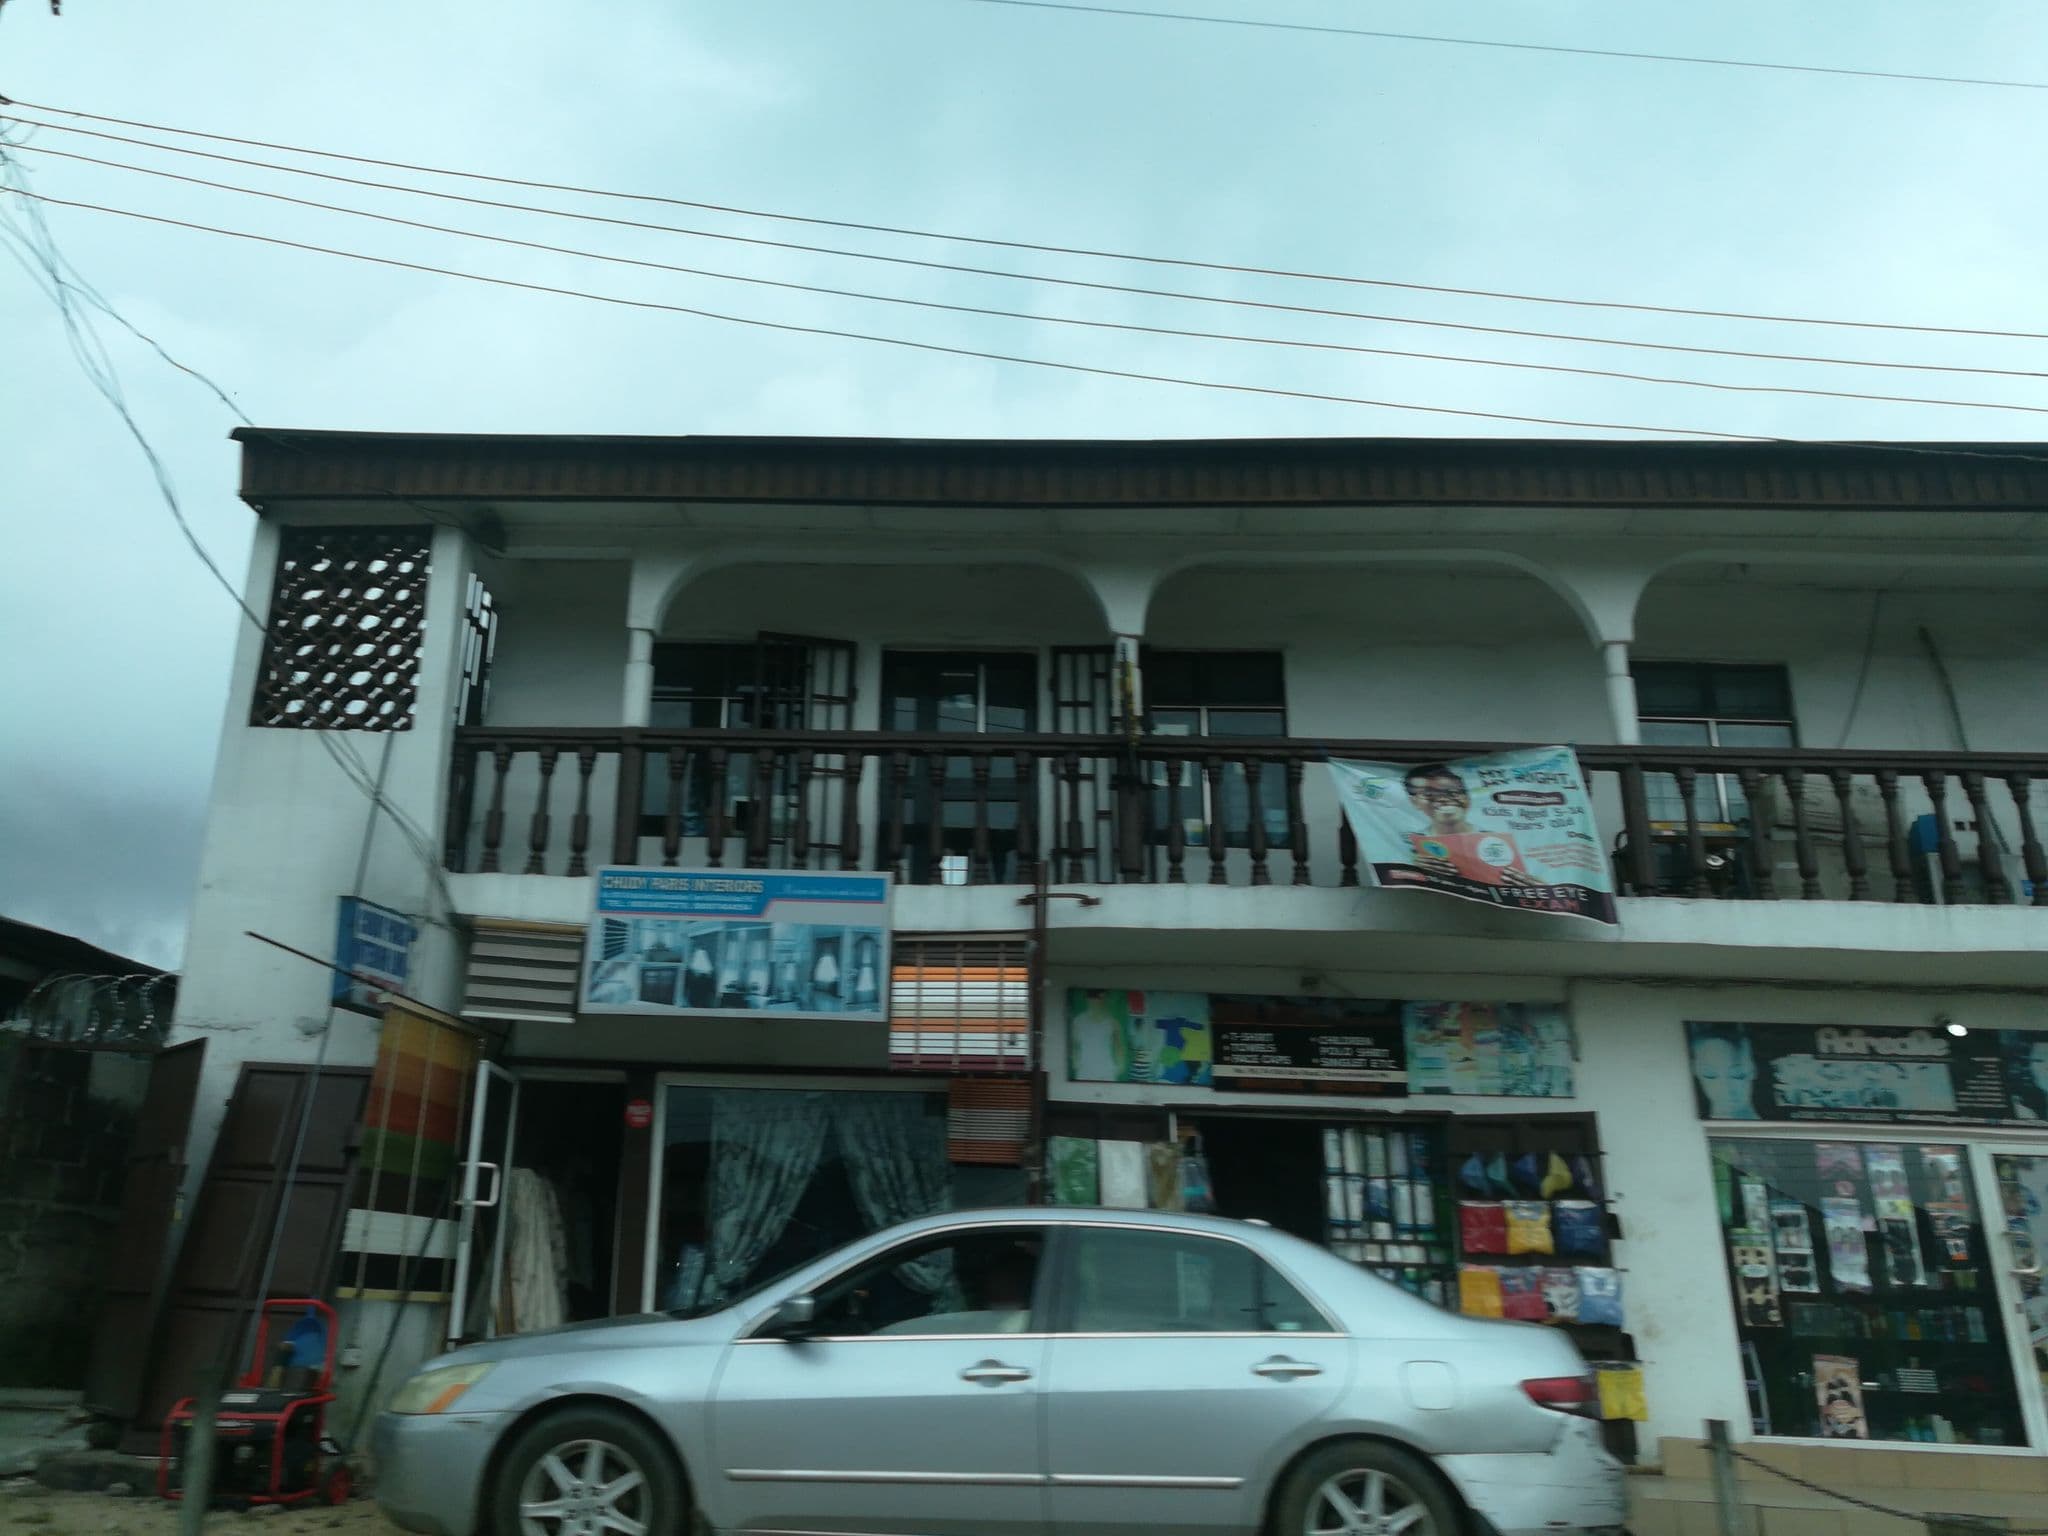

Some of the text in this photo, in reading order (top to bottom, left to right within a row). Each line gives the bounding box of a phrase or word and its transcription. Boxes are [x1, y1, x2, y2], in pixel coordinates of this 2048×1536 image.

[692, 878, 765, 894] INTERIORS
[1501, 886, 1590, 902] FREE EYE
[1520, 898, 1580, 914] EXAM
[1230, 1043, 1277, 1053] TOWELS
[1231, 1054, 1293, 1065] FACE CAPS
